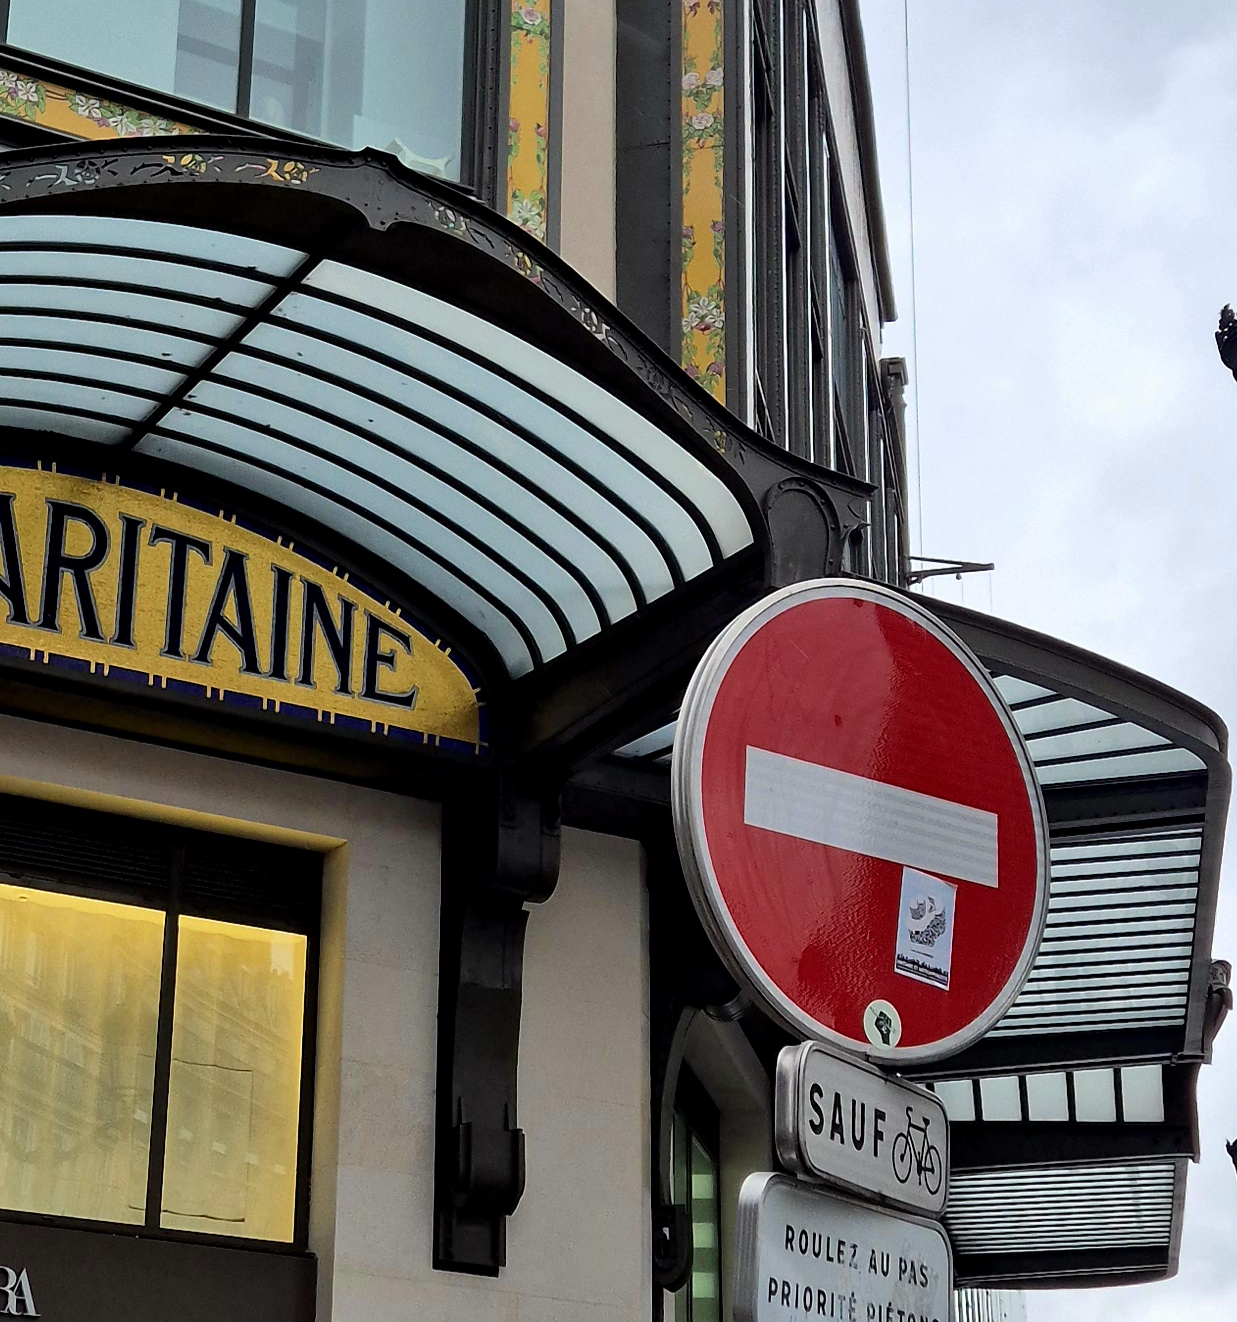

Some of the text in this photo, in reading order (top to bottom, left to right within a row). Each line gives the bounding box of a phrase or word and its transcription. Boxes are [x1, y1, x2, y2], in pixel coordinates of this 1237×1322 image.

[809, 1083, 886, 1157] SAUF
[785, 1224, 929, 1288] ROULEZ AU PAS
[768, 1277, 857, 1322] PRIORITÉ
